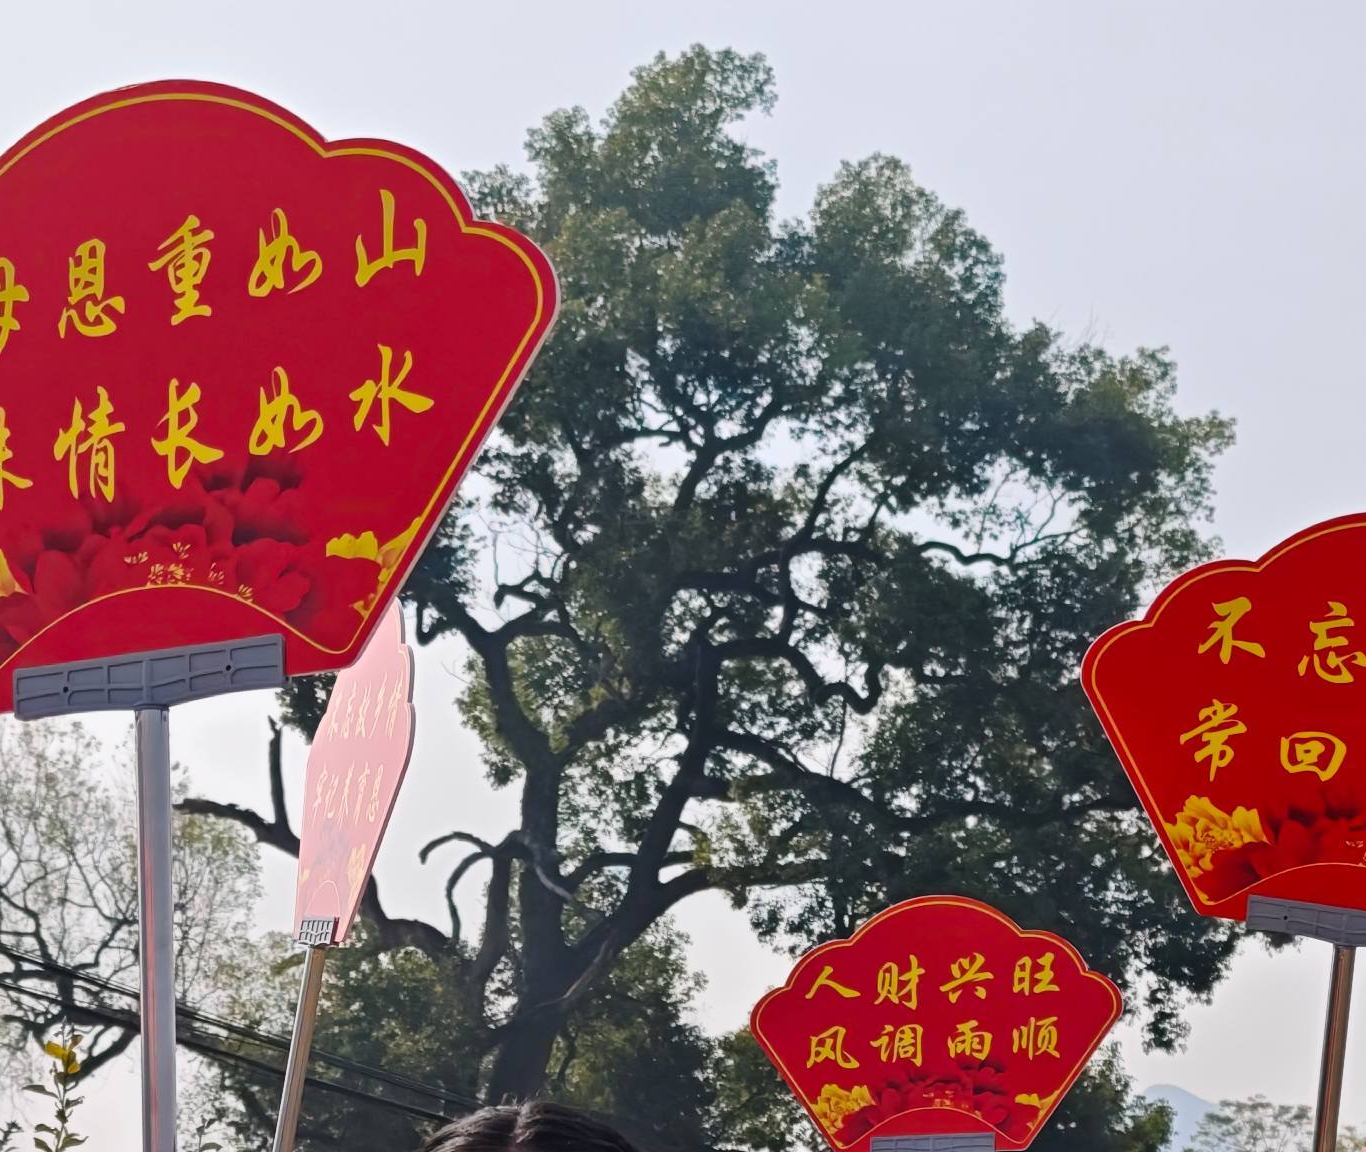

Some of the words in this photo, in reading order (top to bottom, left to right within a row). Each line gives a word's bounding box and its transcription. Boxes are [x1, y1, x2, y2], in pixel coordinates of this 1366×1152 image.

[805, 952, 1060, 1010] 人财兴旺
[806, 1016, 1060, 1069] 风调雨顺
